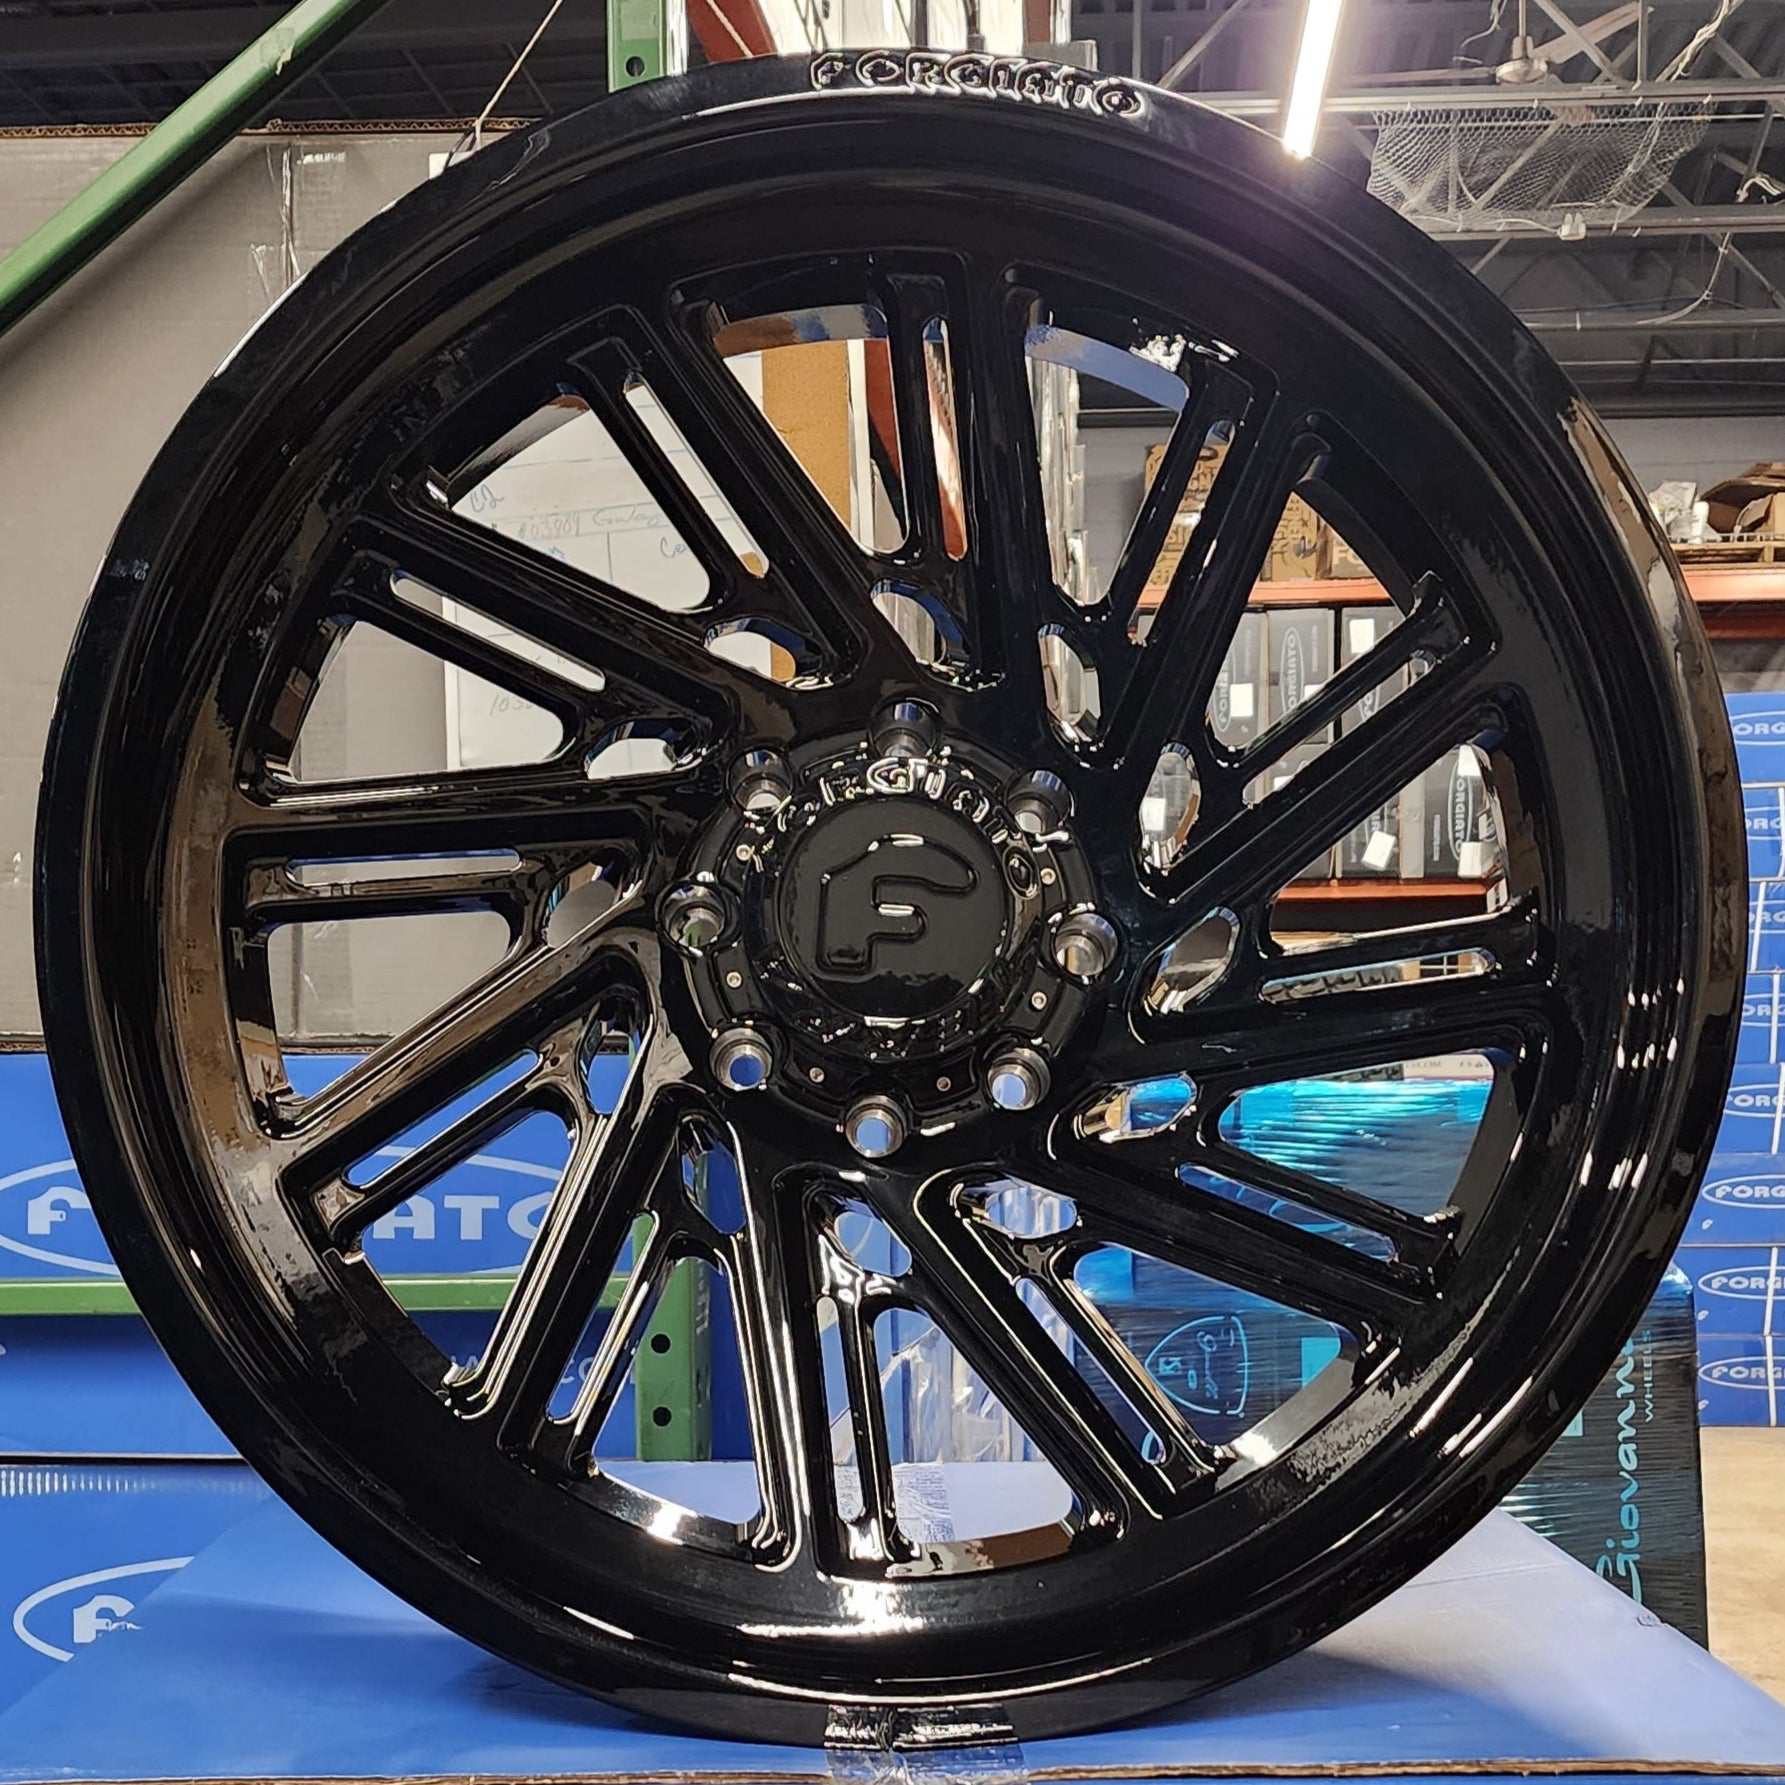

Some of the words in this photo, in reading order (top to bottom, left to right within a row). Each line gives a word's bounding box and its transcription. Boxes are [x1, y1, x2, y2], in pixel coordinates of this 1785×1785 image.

[1733, 721, 1785, 736] ORG
[1454, 778, 1467, 852] ORGIATO
[1711, 1275, 1785, 1290] FORG
